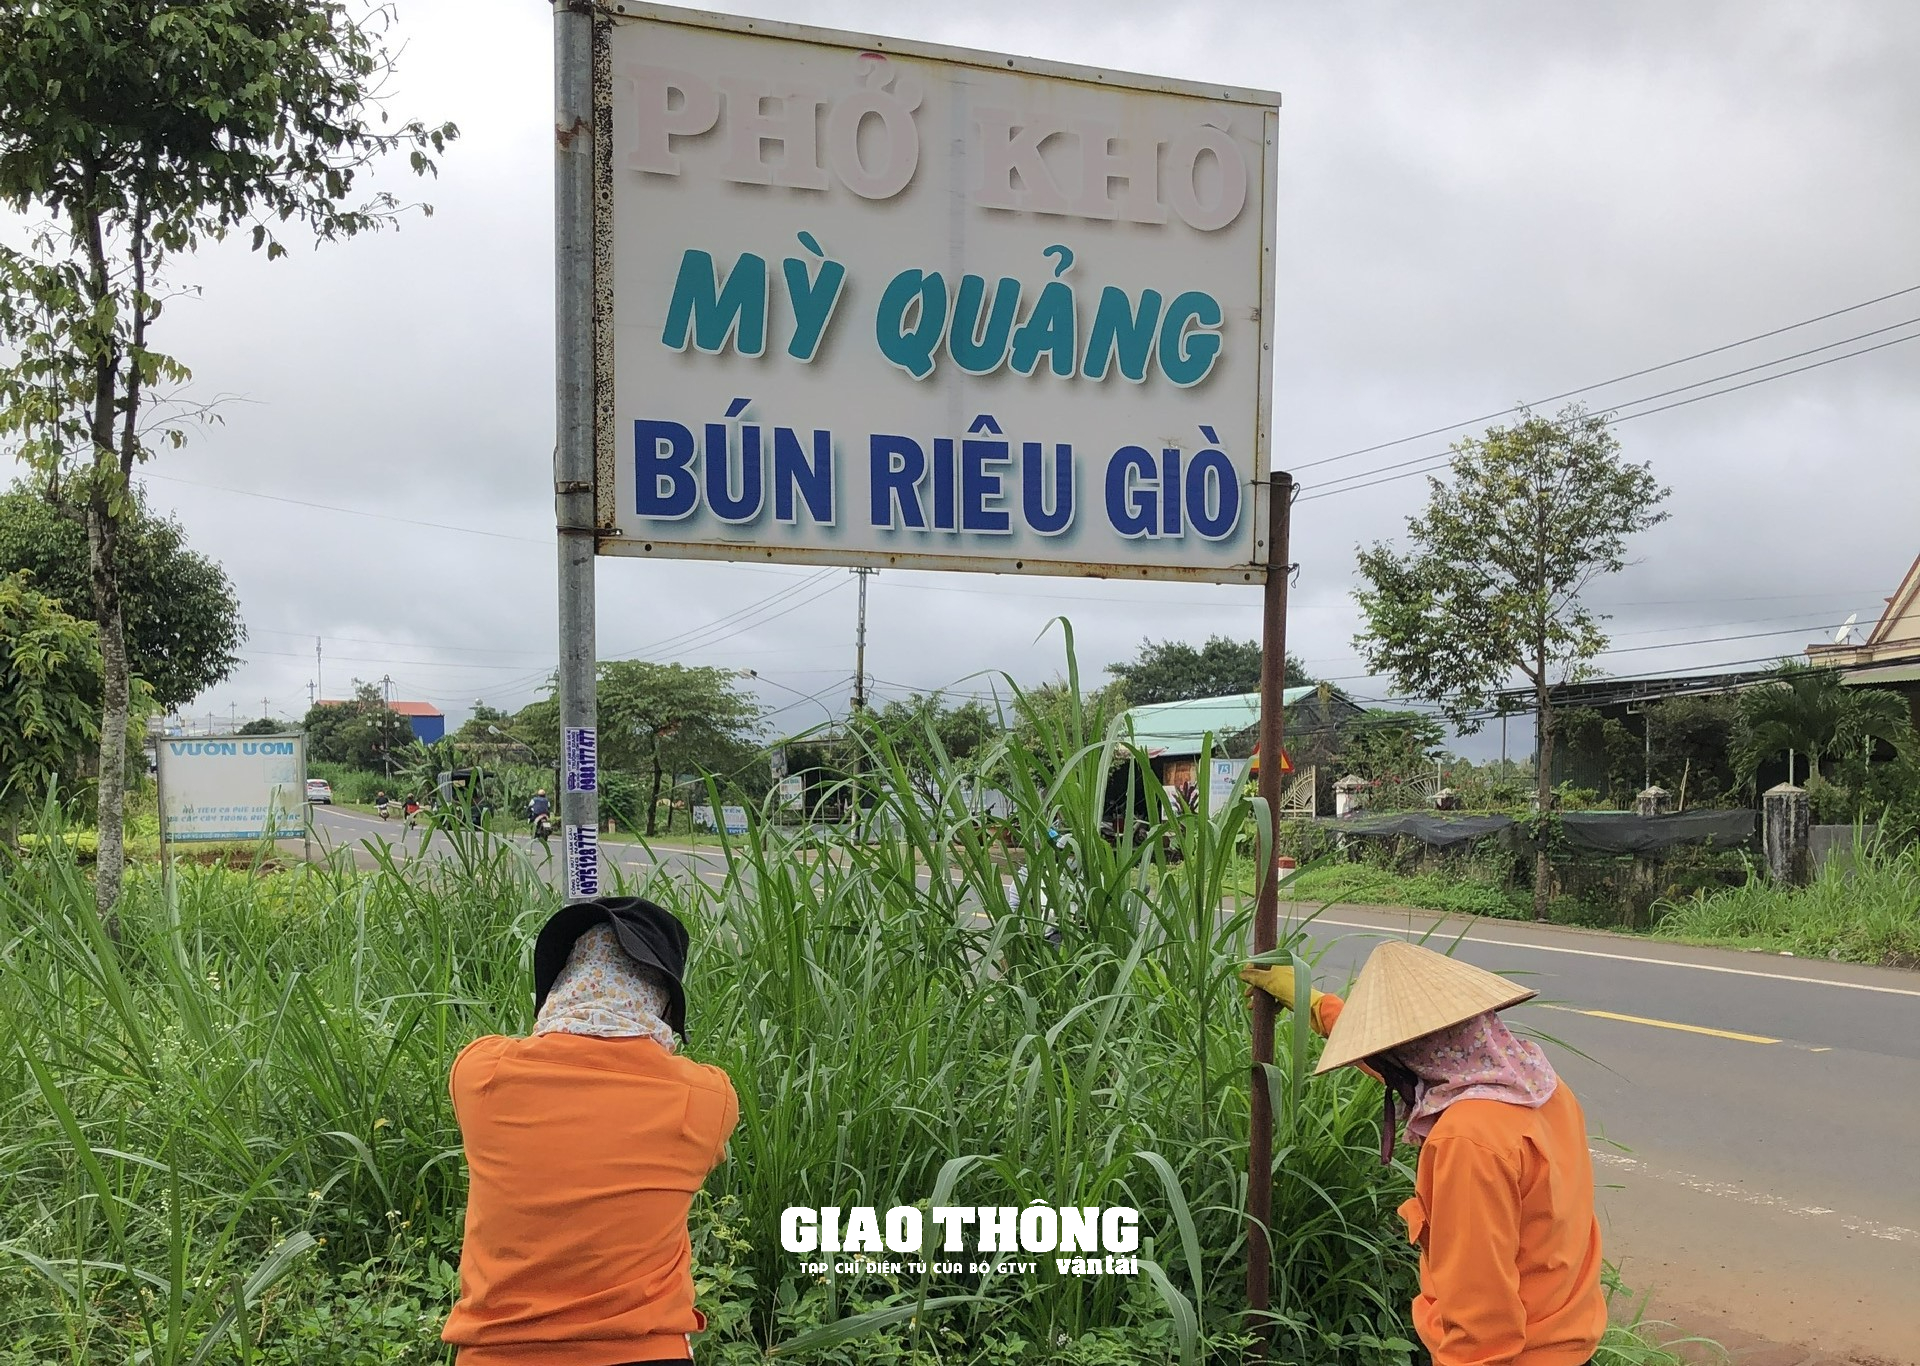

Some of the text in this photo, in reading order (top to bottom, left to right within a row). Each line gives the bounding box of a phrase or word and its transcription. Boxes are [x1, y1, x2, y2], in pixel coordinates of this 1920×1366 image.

[627, 52, 925, 200] PHỞ
[661, 231, 1224, 388] MỲ QUẢNG
[633, 398, 1241, 541] BÚN RIÊU GIÒ
[577, 827, 598, 894] 0975128777
